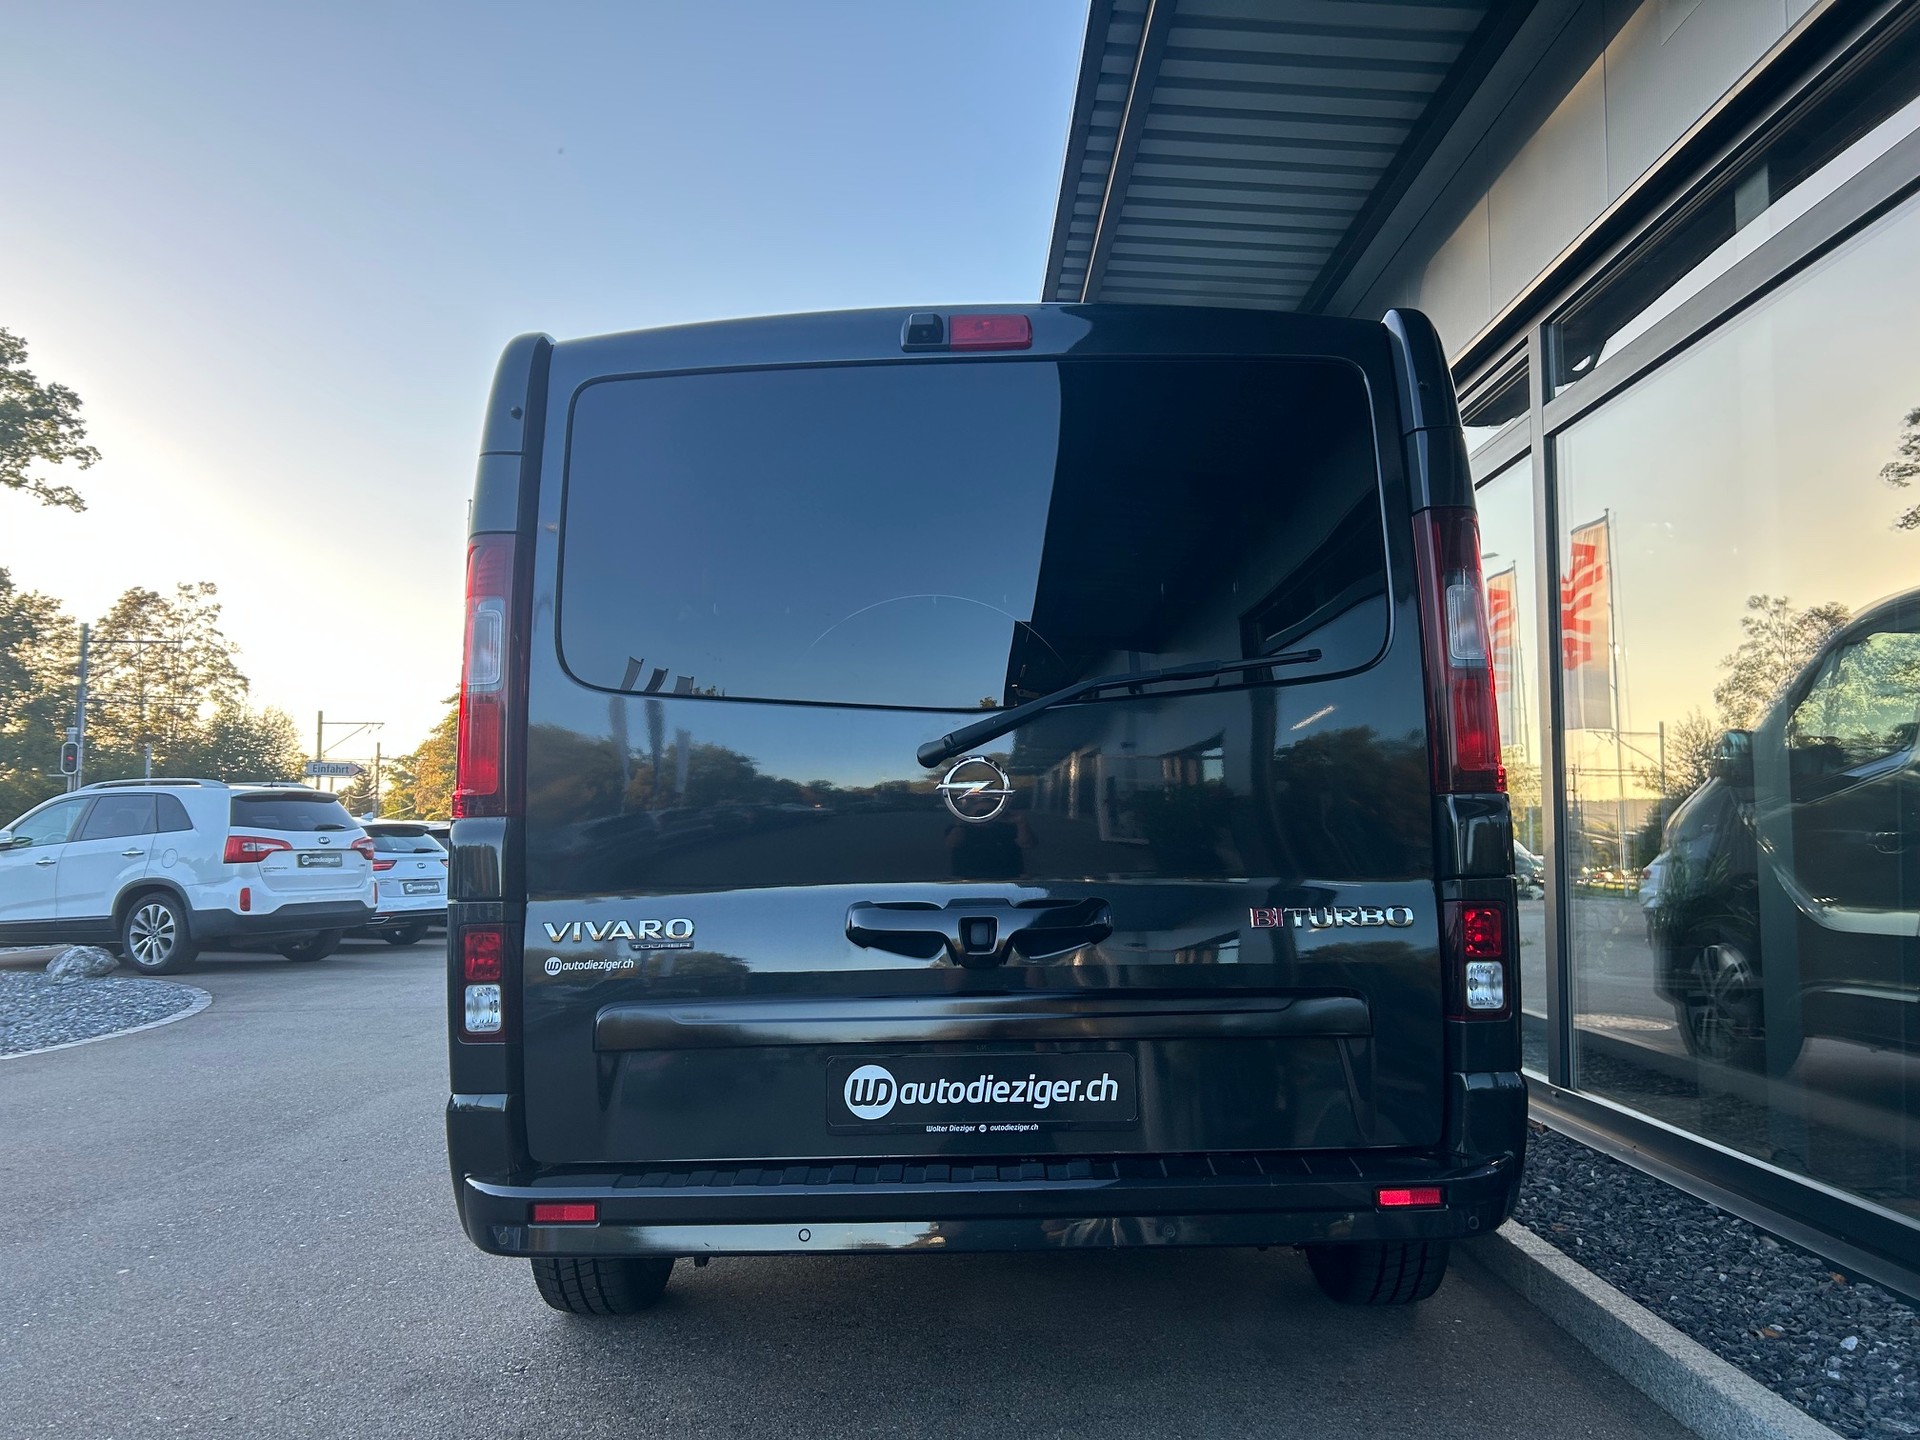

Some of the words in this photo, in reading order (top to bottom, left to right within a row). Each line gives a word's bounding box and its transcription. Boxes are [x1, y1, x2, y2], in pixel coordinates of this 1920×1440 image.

[312, 764, 350, 774] Einfahrt
[543, 918, 694, 942] VIVARO
[632, 942, 691, 950] TOURER
[562, 958, 634, 972] autodieziger.ch
[900, 1073, 1119, 1109] autodieziger.ch
[926, 1125, 948, 1133] Walter
[949, 1124, 976, 1133] Dieziger
[990, 1123, 1039, 1132] autodieziger.ch
